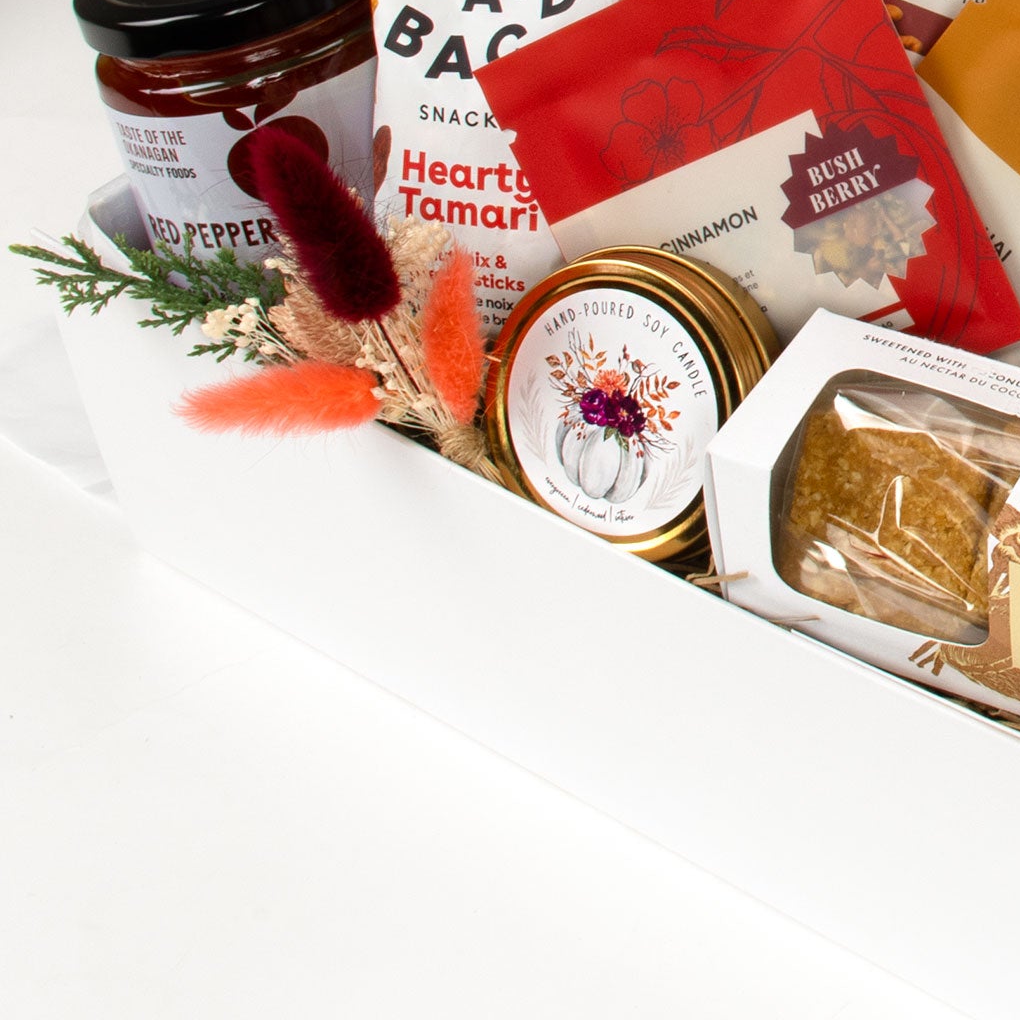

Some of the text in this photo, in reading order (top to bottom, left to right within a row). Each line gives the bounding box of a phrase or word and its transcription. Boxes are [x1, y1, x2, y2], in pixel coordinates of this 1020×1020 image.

[384, 5, 528, 79] BAC
[144, 129, 158, 145] OF
[160, 130, 187, 146] THE
[166, 167, 197, 179] FOODS
[402, 149, 536, 203] Hearty
[806, 147, 865, 187] BUSH
[808, 164, 881, 214] BERRY
[398, 187, 539, 232] Tamari
[148, 213, 280, 249] RED PEPPER
[660, 206, 758, 254] CINNAMON
[473, 251, 507, 270] ix &
[485, 298, 515, 312] noix
[544, 301, 708, 399] HAND-POURED SOY CANDLE
[862, 334, 932, 359] SWEETENED
[936, 354, 967, 370] WITH
[899, 355, 918, 365] AU
[920, 361, 966, 381] NECTAR
[969, 375, 987, 386] DU
